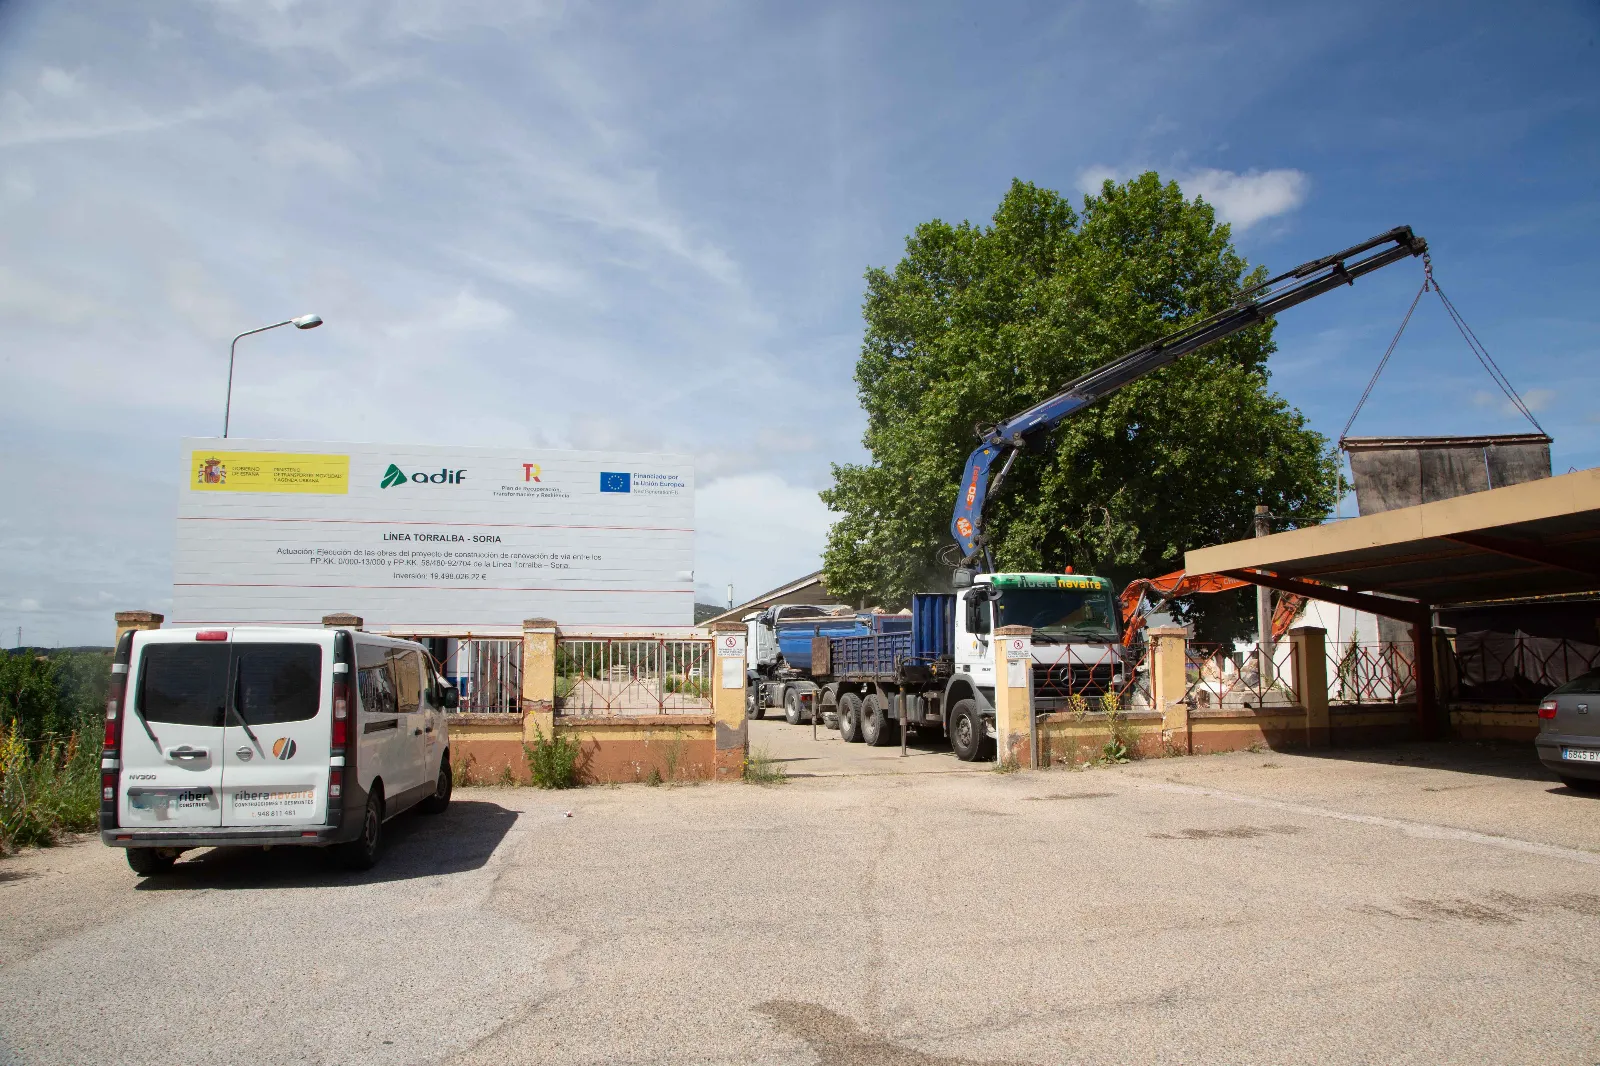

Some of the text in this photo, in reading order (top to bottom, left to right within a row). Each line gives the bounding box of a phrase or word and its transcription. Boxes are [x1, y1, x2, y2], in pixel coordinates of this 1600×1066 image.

[411, 468, 467, 484] adif
[383, 531, 411, 541] LÍNEA
[413, 533, 465, 542] TORRALBA
[472, 535, 502, 543] SORIA
[277, 547, 315, 555] Actuación:
[316, 548, 352, 556] Ejecución
[411, 550, 442, 559] proyecto
[510, 552, 549, 560] renovación
[514, 561, 543, 569] Torralba
[393, 572, 428, 580] Inversión:
[1568, 750, 1587, 759] 6845
[235, 790, 315, 801] riberanavarra
